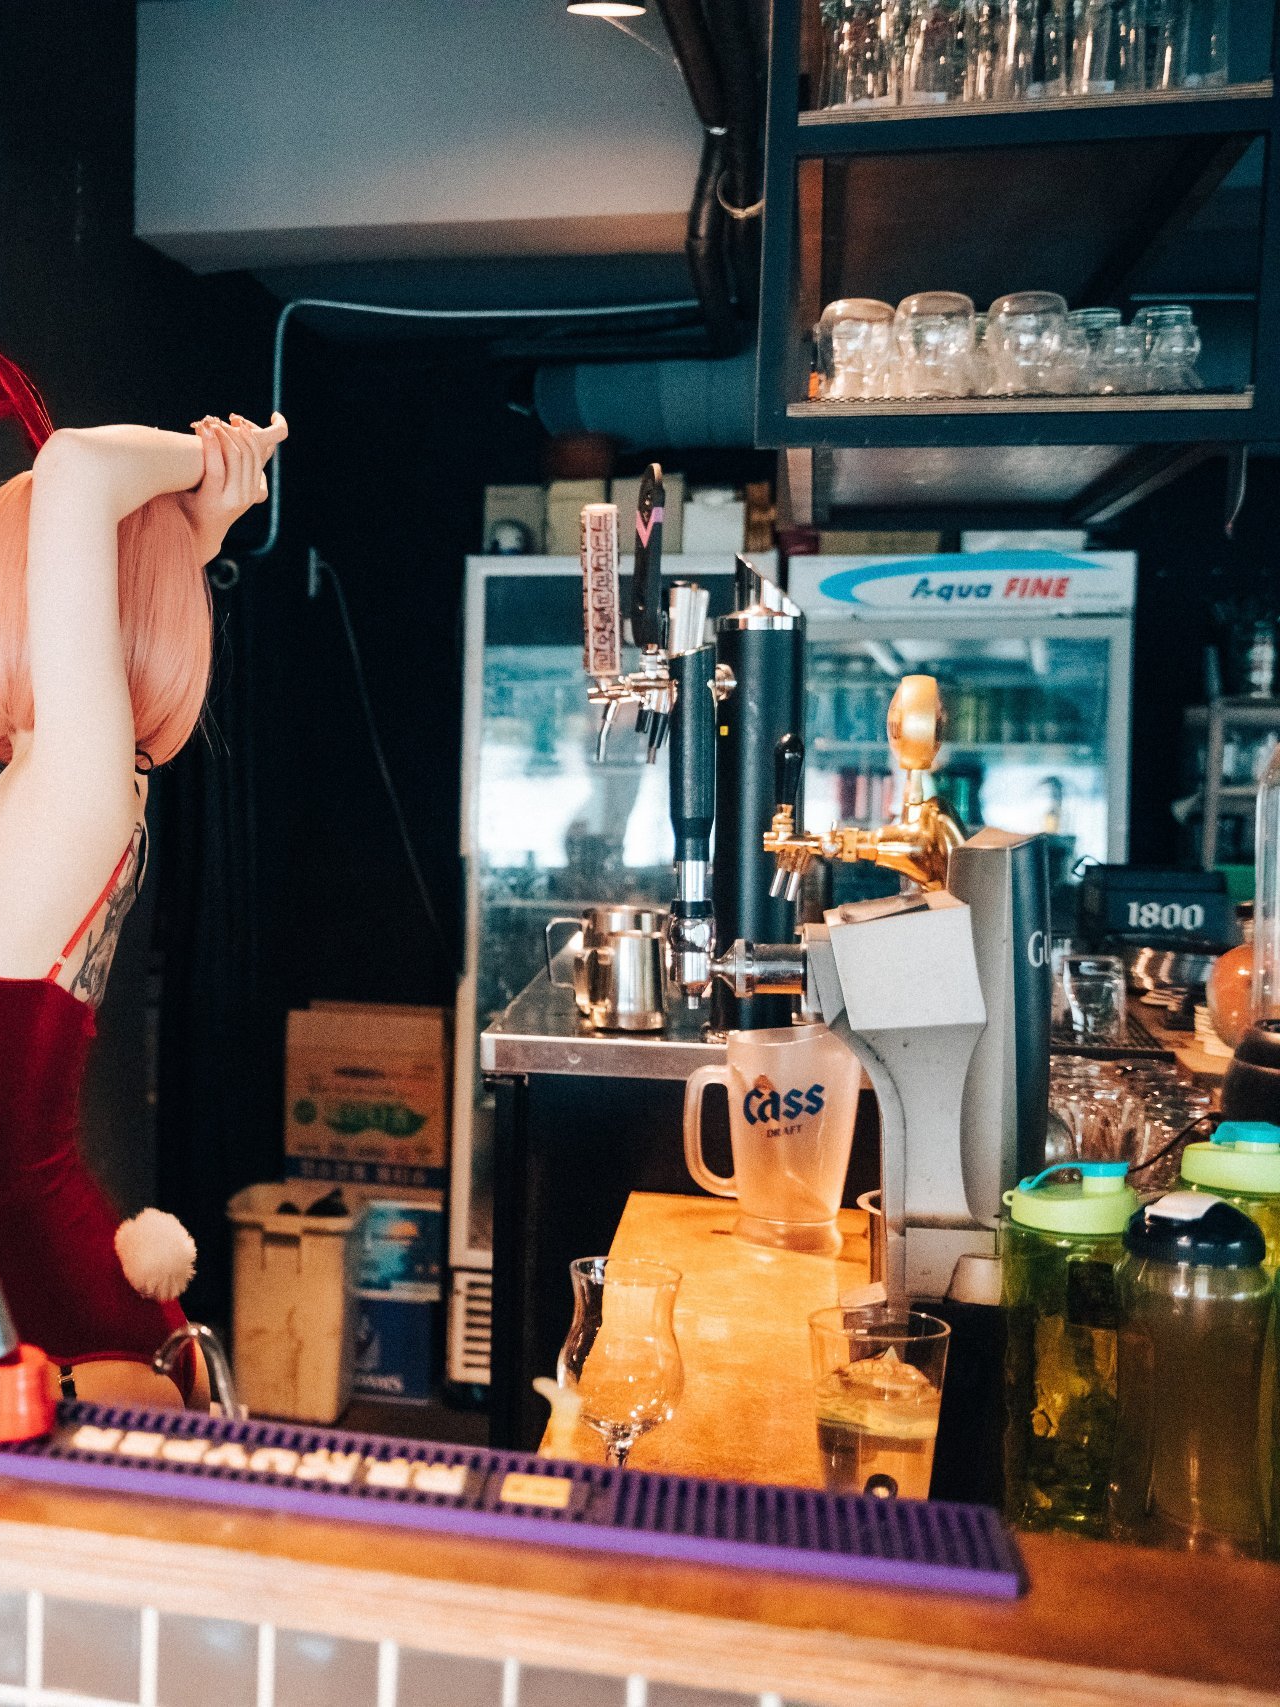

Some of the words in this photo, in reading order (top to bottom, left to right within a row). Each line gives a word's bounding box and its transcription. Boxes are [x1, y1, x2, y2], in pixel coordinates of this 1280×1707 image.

[910, 577, 993, 602] Aqua
[1003, 576, 1071, 600] FINE
[1127, 902, 1204, 931] 1800
[743, 1083, 825, 1126] Cass
